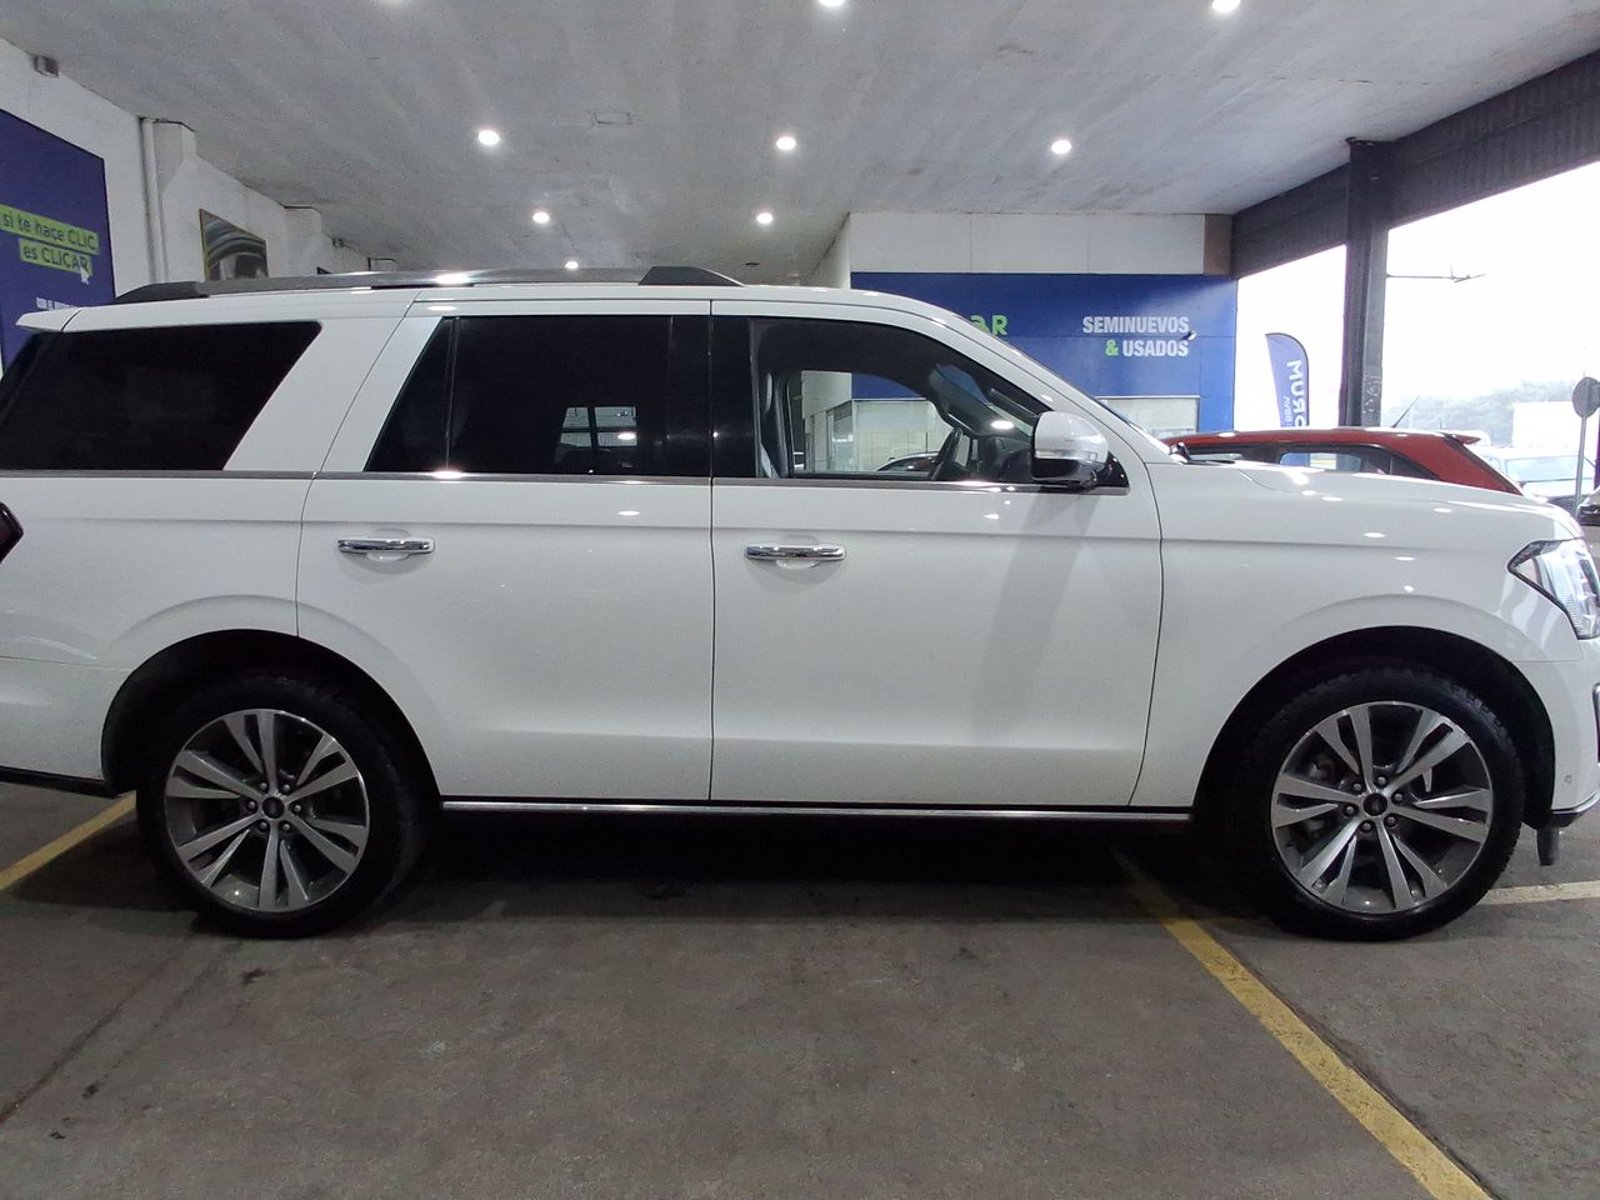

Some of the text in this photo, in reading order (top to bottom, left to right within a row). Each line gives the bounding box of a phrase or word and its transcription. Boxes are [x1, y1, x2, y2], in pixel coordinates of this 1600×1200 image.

[18, 213, 31, 232] te
[35, 220, 64, 242] hace
[67, 229, 97, 250] CLIC
[23, 245, 89, 273] es CLICAR
[1082, 316, 1189, 334] SEMINUEVOS
[1105, 339, 1189, 357] & USADOS
